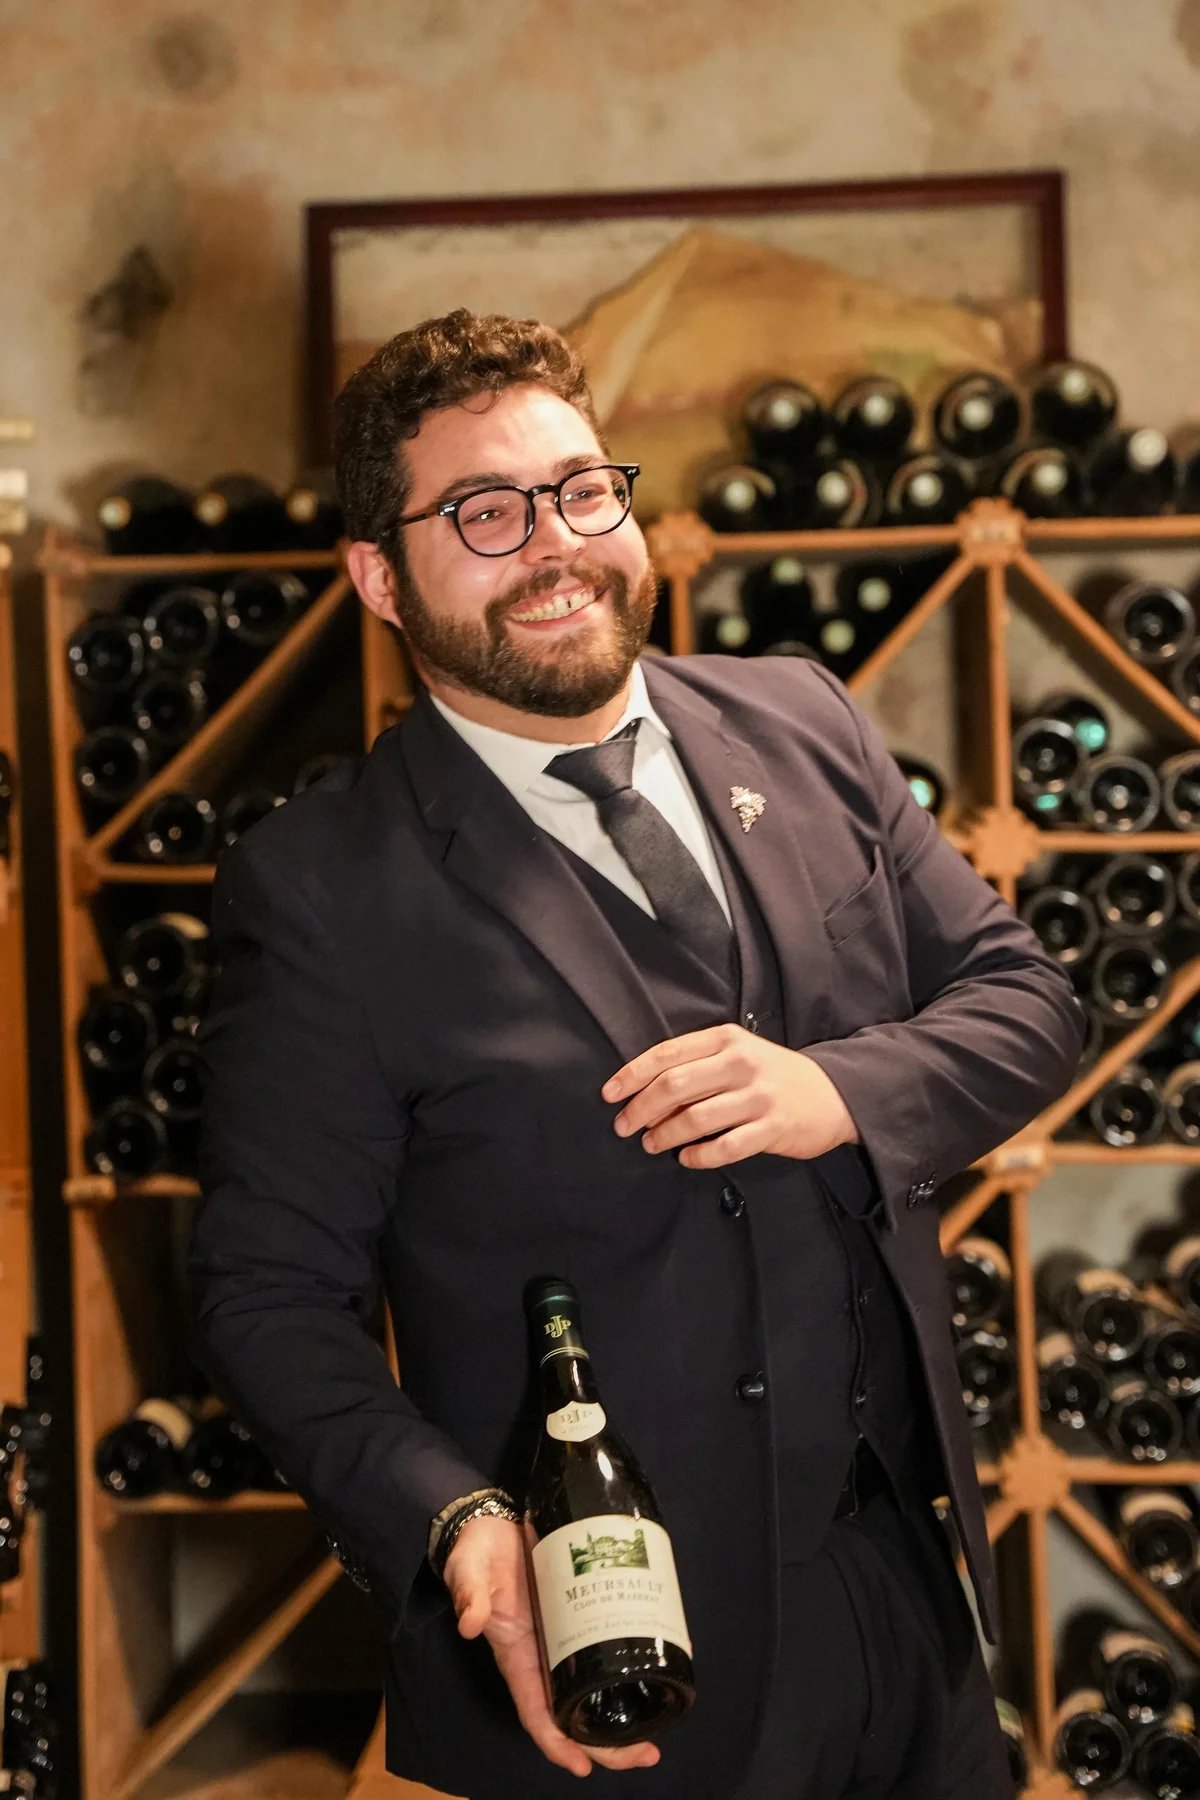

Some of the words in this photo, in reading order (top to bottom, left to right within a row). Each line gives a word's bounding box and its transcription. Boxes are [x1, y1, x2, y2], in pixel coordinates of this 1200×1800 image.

[543, 1314, 572, 1339] DJP
[564, 1578, 664, 1604] MEURSAULT
[573, 1597, 598, 1612] CLOS
